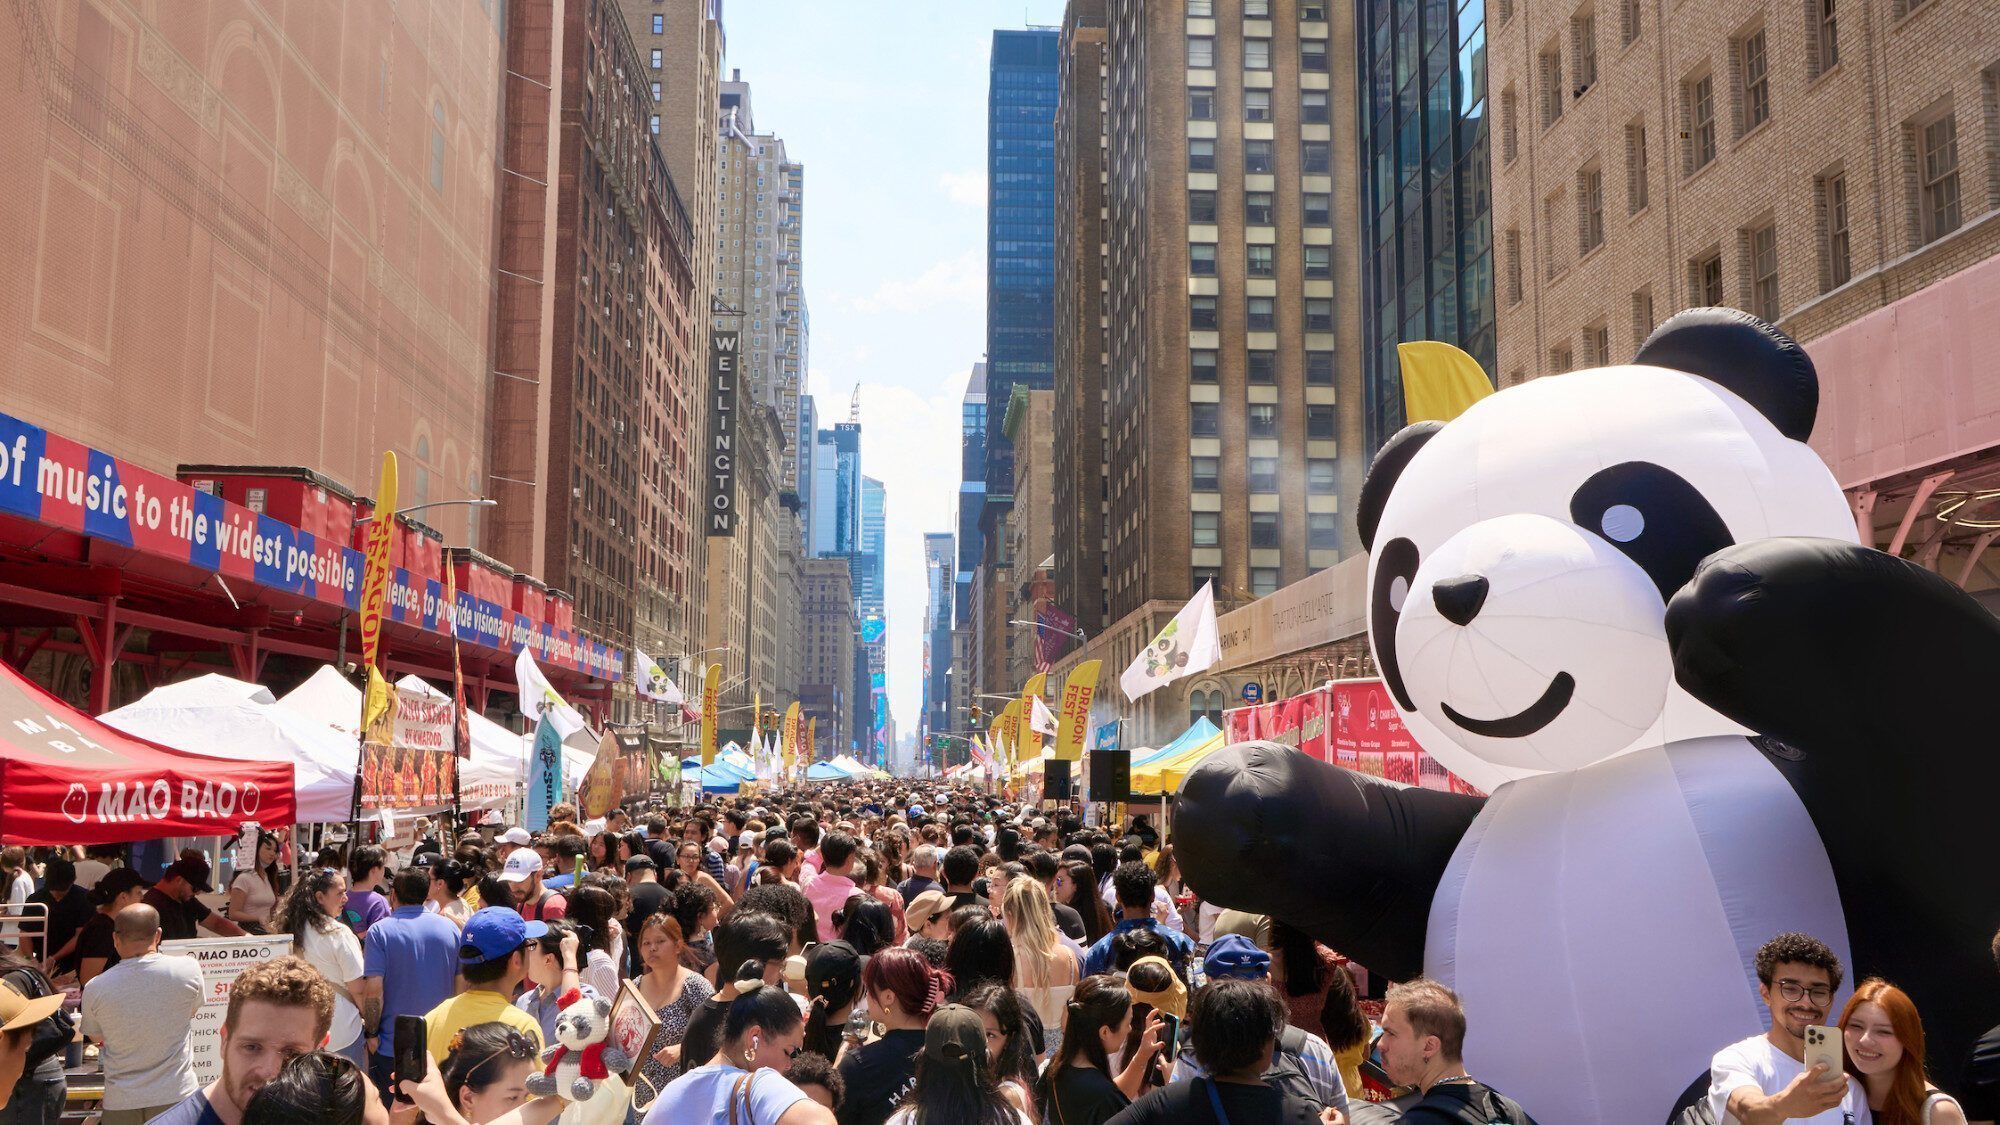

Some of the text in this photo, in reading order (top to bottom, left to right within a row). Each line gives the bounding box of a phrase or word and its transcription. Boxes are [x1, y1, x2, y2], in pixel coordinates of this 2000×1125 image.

[714, 337, 736, 529] WELLINGTON
[0, 435, 27, 486] of
[37, 456, 127, 519] music
[135, 484, 161, 530] to
[170, 496, 208, 545] the
[215, 513, 282, 569] widest
[286, 545, 354, 592] possible
[384, 571, 420, 619] ience,
[423, 588, 435, 616] to
[474, 604, 512, 646] visionary
[512, 620, 544, 650] education
[544, 633, 573, 663] programs,
[361, 521, 382, 602] FEST
[361, 512, 392, 664] DRAGON
[398, 697, 420, 721] FRIED
[704, 687, 713, 721] FEST
[1024, 695, 1033, 724] FEST
[1063, 684, 1079, 719] FEST
[1072, 687, 1092, 745] DRAGON
[788, 718, 796, 754] DRAGON
[1003, 715, 1011, 737] FEST
[96, 779, 237, 823] MAO BAO
[459, 784, 493, 800] ANDMADE
[198, 948, 258, 960] MAO BAO
[192, 1060, 212, 1068] AMB
[193, 1045, 212, 1053] EEF
